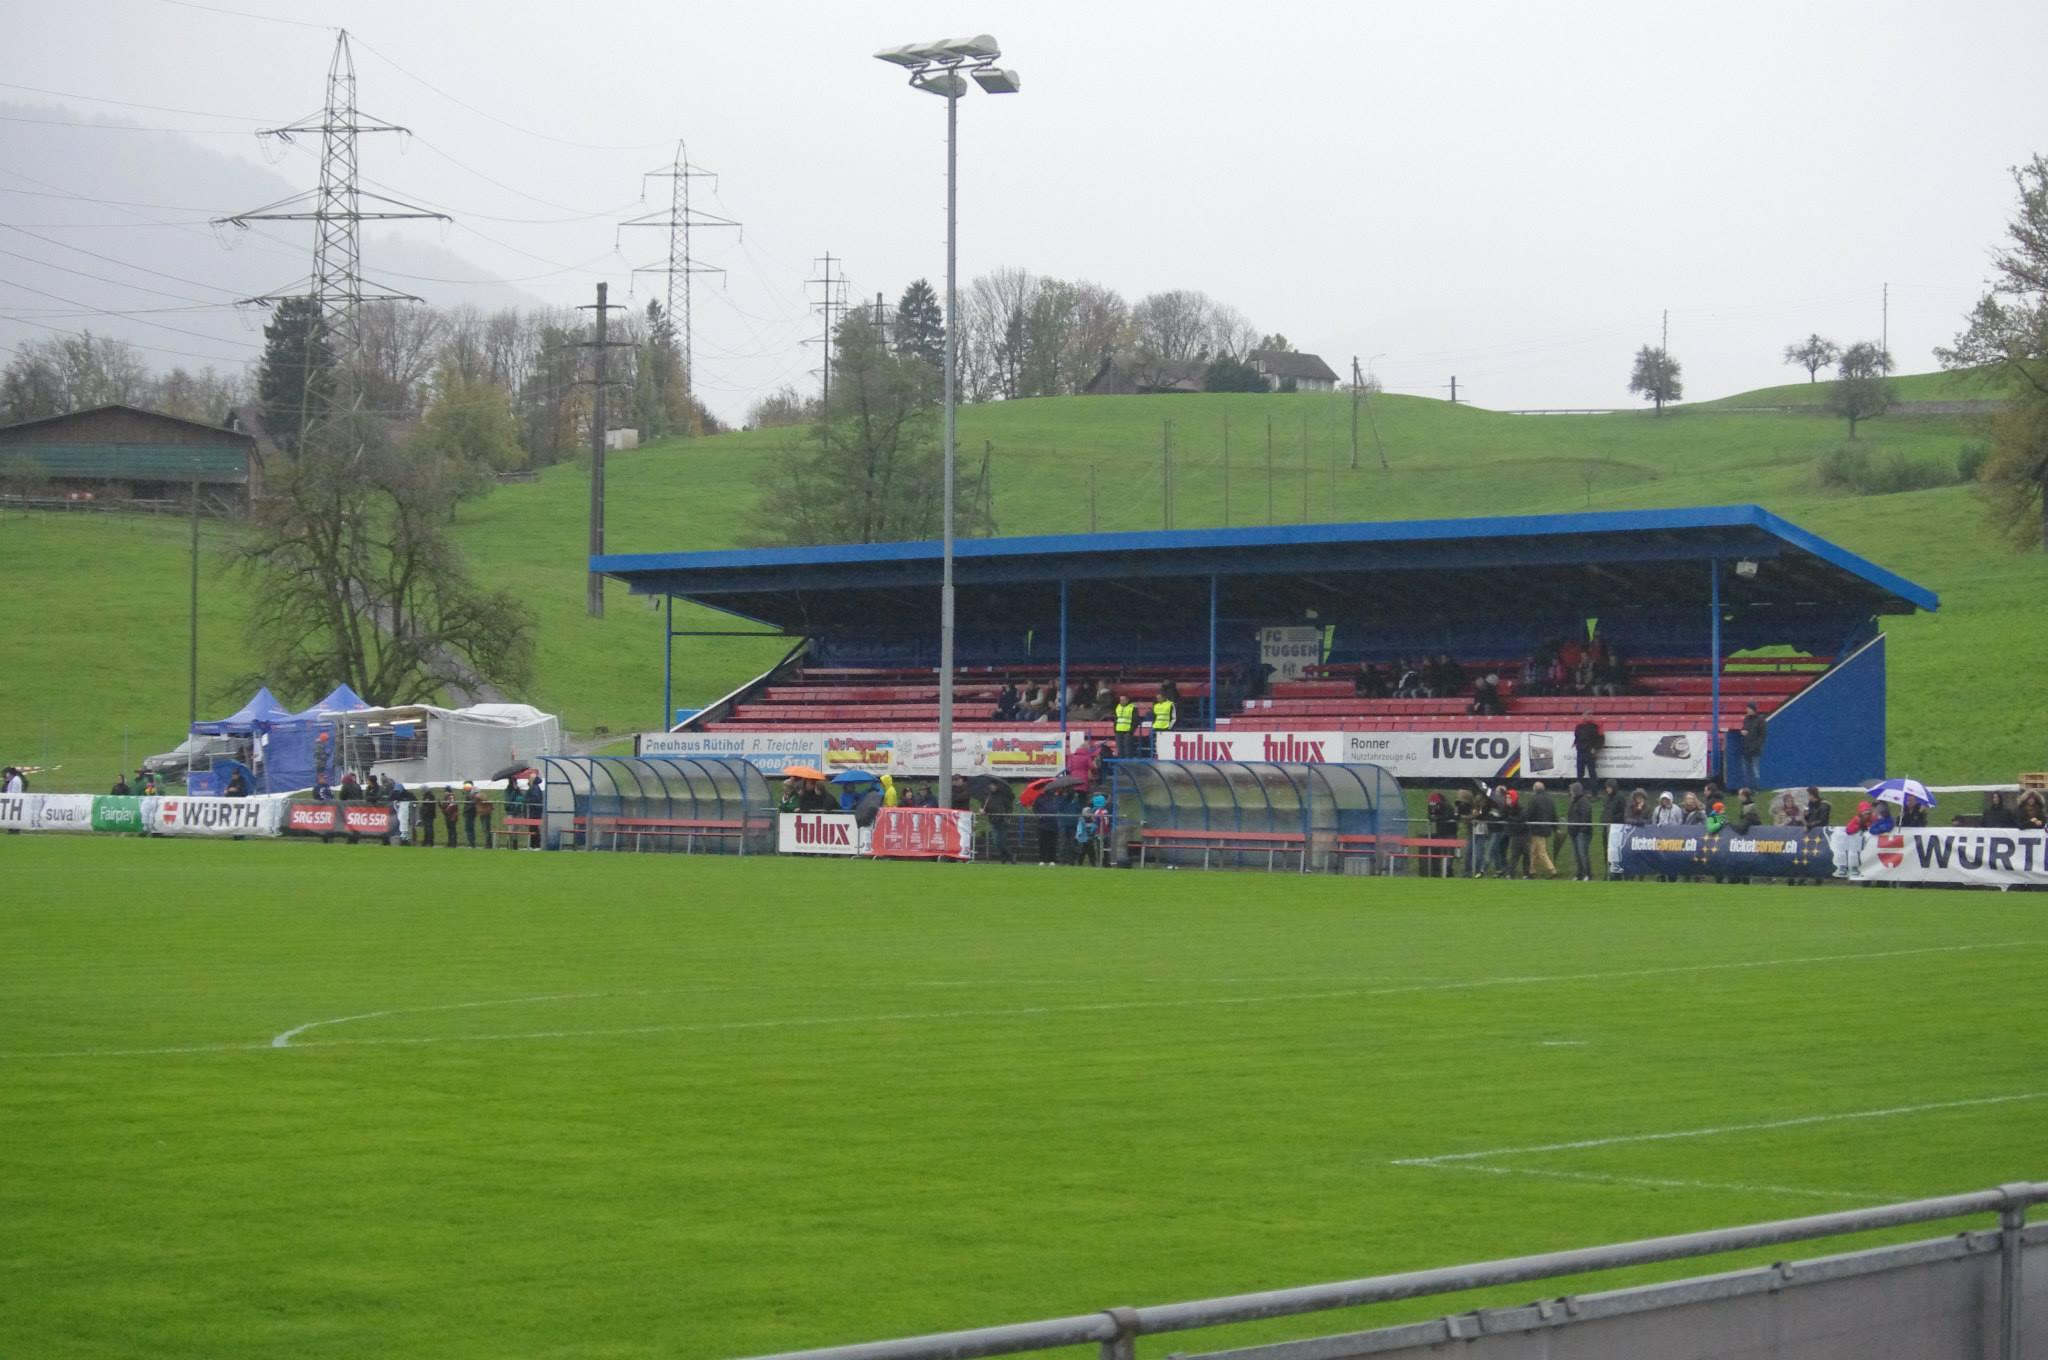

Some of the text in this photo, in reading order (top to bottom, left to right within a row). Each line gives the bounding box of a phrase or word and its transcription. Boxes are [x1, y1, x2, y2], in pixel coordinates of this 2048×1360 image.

[1264, 630, 1282, 642] FC
[1263, 645, 1318, 657] TUGGEN
[646, 738, 814, 751] Pneuhaus Rütihof R. Treichler
[1174, 734, 1233, 761] tulux
[1264, 734, 1326, 762] tulux
[1351, 737, 1390, 750] Ronner
[1432, 737, 1510, 759] IVECO
[1351, 752, 1417, 762] Nutzfahrzeuge AG
[100, 805, 135, 824] Fairplay
[183, 803, 260, 828] WÜRTH
[292, 810, 333, 825] SRG SSR
[346, 812, 388, 827] SRG SSR
[795, 815, 850, 846] tulux
[1631, 836, 1698, 852] ticketcorner.ch
[1729, 838, 1798, 854] ticketcorner.ch
